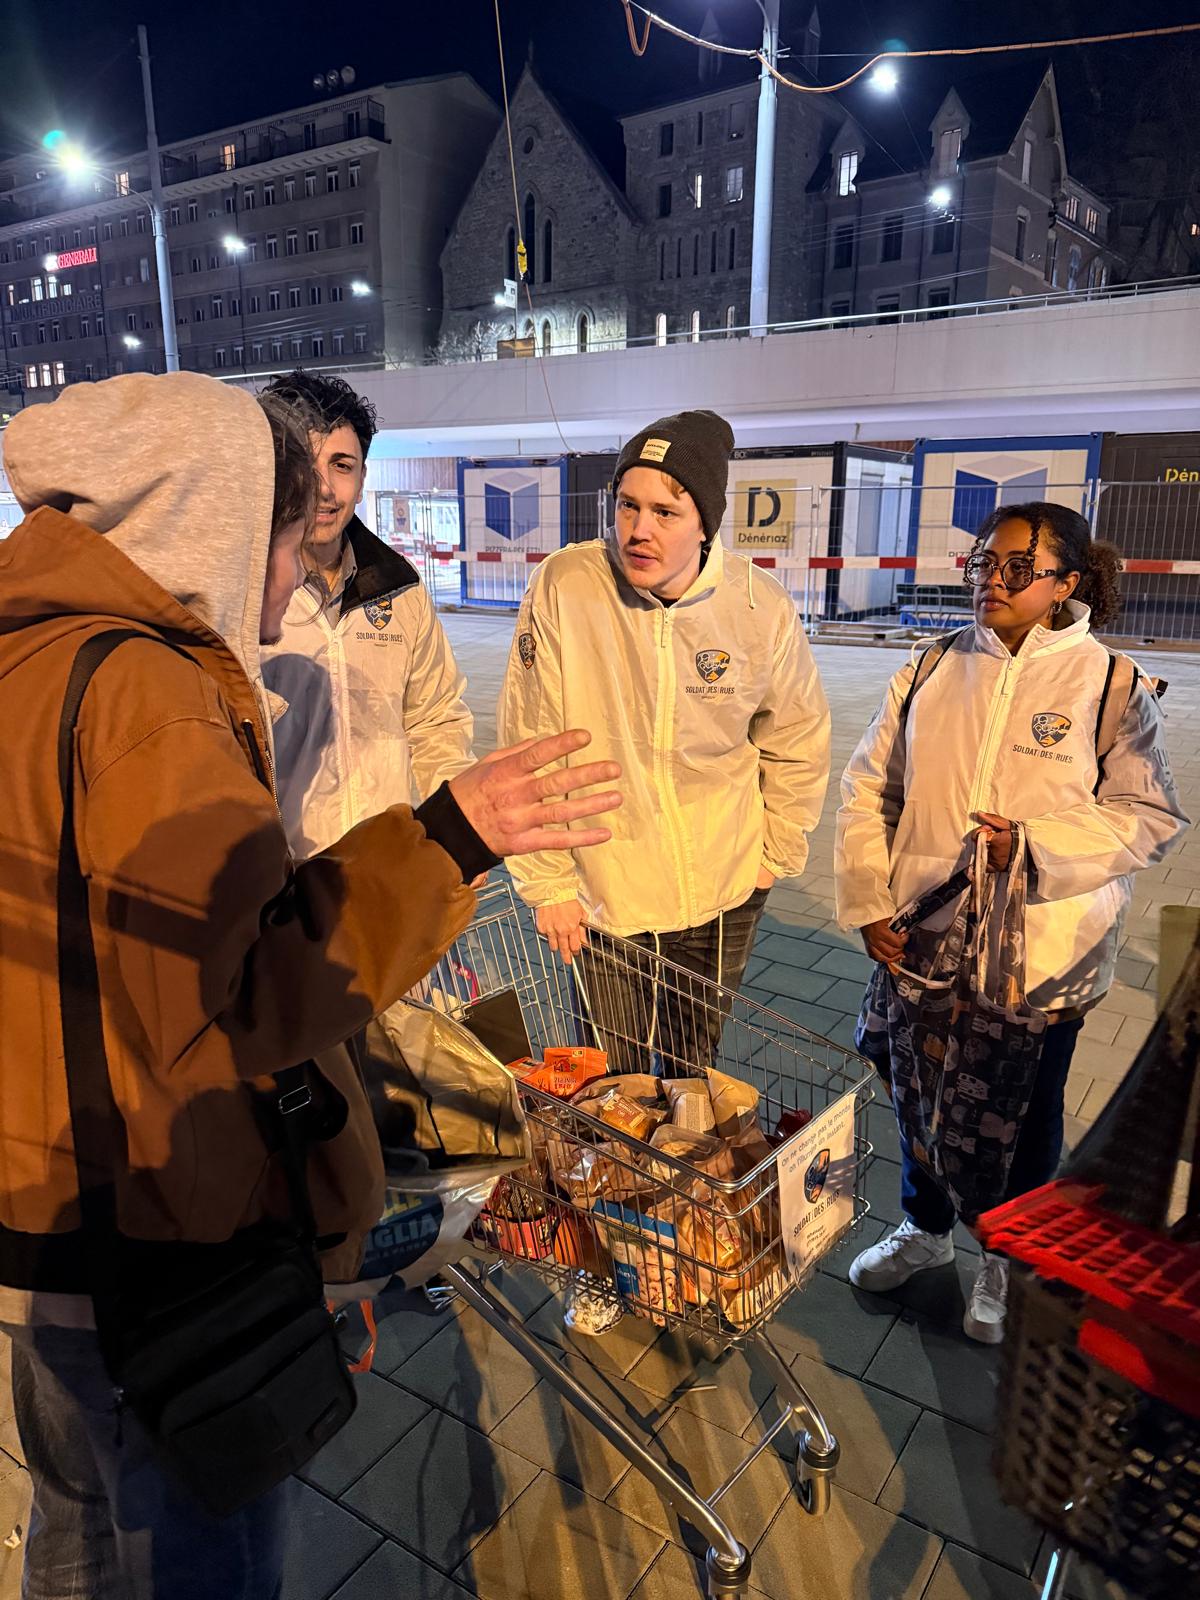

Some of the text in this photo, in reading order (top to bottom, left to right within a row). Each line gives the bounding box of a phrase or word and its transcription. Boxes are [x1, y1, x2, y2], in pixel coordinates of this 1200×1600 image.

[57, 247, 98, 269] GENERALI
[738, 532, 788, 543] Dénériaz
[356, 632, 376, 640] SOLDAT
[378, 633, 389, 641] DES
[685, 686, 735, 695] SOLDAT DES RUES
[1012, 744, 1073, 764] SOLDAT DES RUES
[798, 1133, 817, 1152] change
[817, 1125, 827, 1138] pas
[793, 1212, 811, 1238] SOLDAT
[814, 1202, 824, 1218] DES
